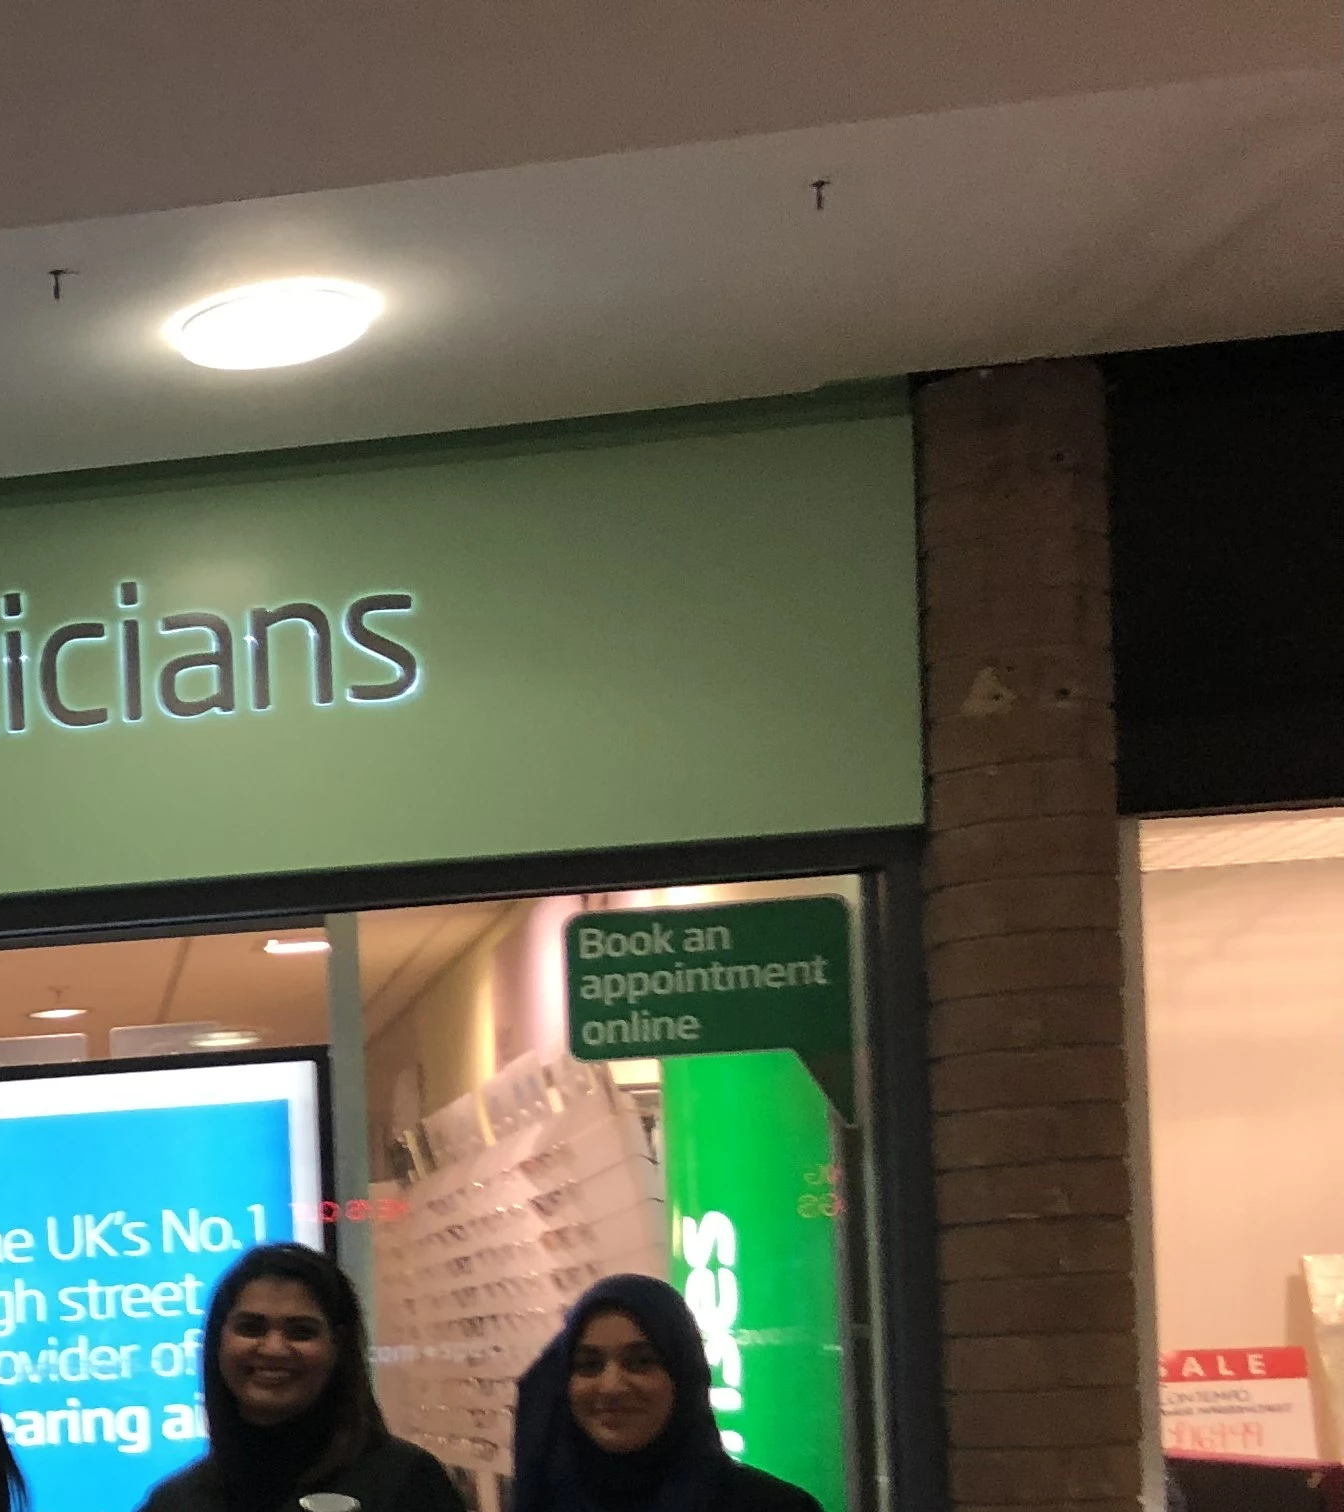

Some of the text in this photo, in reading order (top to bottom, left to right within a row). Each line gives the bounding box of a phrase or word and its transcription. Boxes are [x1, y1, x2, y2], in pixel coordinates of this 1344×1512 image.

[578, 922, 732, 960] Book an
[580, 955, 831, 1006] appointment
[582, 1010, 701, 1046] online
[47, 1212, 148, 1261] UK's
[59, 1273, 205, 1322] street
[151, 1328, 206, 1378] of
